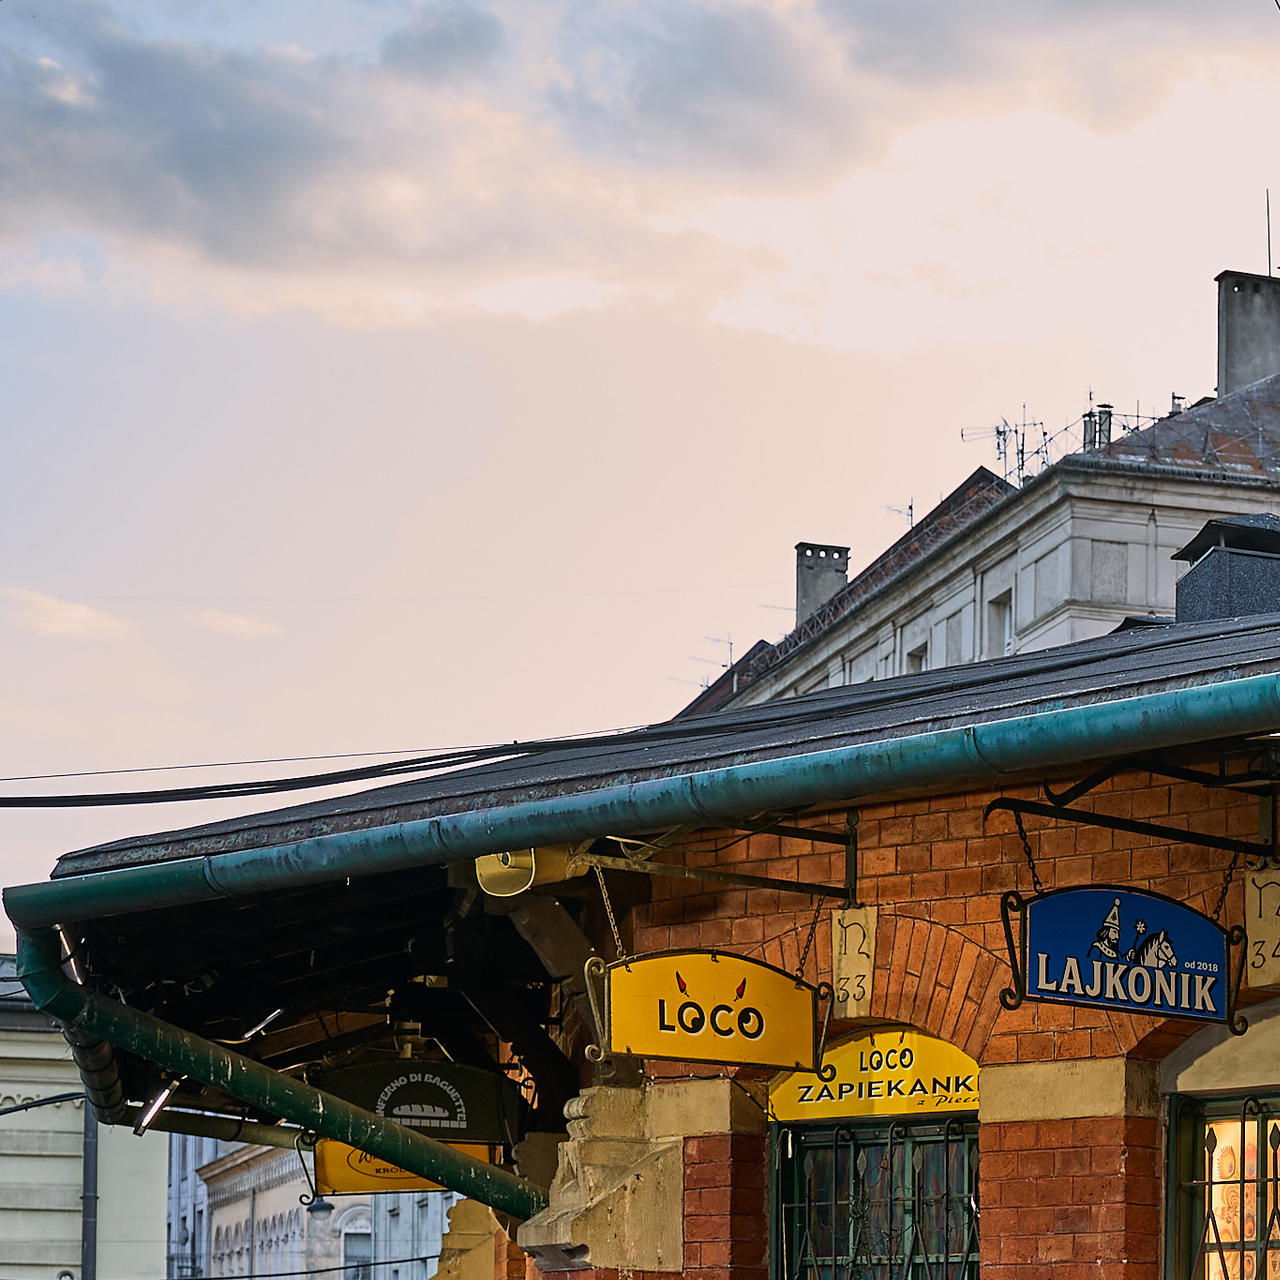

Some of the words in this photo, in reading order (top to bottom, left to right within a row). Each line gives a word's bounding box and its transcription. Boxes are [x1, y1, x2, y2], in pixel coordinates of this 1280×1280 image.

[1037, 952, 1218, 1014] LAJKONIK
[1184, 960, 1196, 969] od
[1197, 960, 1218, 972] 2018
[837, 975, 866, 1003] 33
[657, 998, 765, 1040] LOCO
[859, 1048, 914, 1072] LOCO
[409, 1073, 422, 1082] DI
[424, 1074, 467, 1121] BAGUETTE
